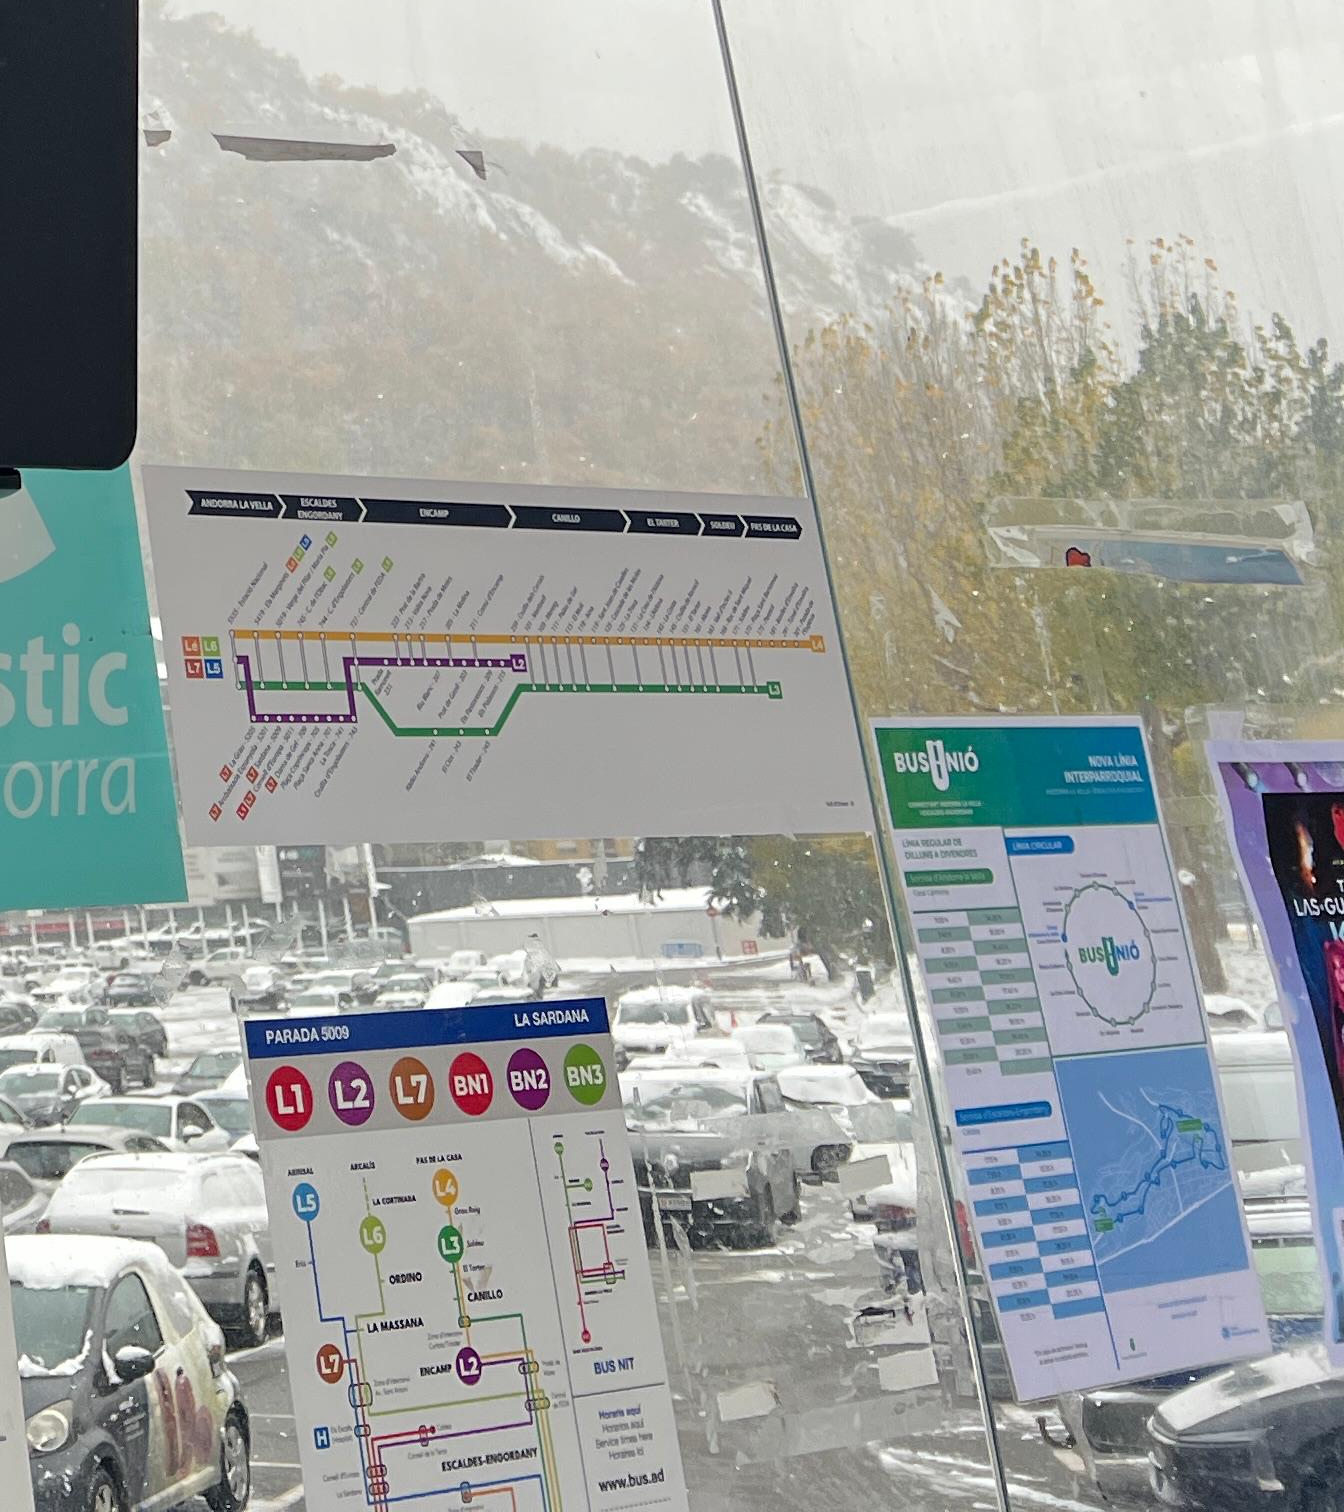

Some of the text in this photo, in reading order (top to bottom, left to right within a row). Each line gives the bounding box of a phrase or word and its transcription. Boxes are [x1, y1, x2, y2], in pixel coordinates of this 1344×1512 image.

[201, 499, 273, 510] ANDORRA LA VELLA
[300, 498, 337, 508] ESCALDES
[297, 510, 343, 520] ENGORDANY
[419, 509, 450, 518] ENCAMP
[552, 514, 580, 523] CANILLO
[647, 518, 679, 528] EL TARTER
[751, 522, 762, 530] PAS
[763, 523, 771, 531] DE
[781, 524, 797, 532] CASA
[187, 661, 220, 674] L7 L5
[513, 659, 524, 669] L2
[1088, 753, 1138, 767] NOVA LÍNIA
[1064, 770, 1143, 783] INTERPARROQUIAL
[1013, 840, 1062, 851] LÍNIA CIRCULAR
[940, 849, 977, 858] DIVENDRES
[514, 1009, 589, 1027] LA SARDANA
[265, 1025, 350, 1045] PARADA 5009
[275, 1064, 604, 1115] L1 L2 L7 BN1 BN2 BN3
[350, 1161, 375, 1170] ARCALÍS
[435, 1179, 456, 1196] L4
[296, 1194, 316, 1212] L5
[363, 1226, 383, 1245] L6
[441, 1236, 460, 1255] L3
[390, 1272, 422, 1285] ORDINO
[468, 1289, 503, 1302] CANILLO
[367, 1317, 424, 1333] LA MASSANA
[319, 1355, 339, 1374] L7
[420, 1364, 452, 1377] ENCAMP
[459, 1357, 479, 1376] L2
[594, 1357, 634, 1374] BUS NIT
[599, 1408, 624, 1420] Horaris
[441, 1447, 538, 1472] ESCALDES-ENGORDANY
[599, 1469, 665, 1492] www.bus.ad
